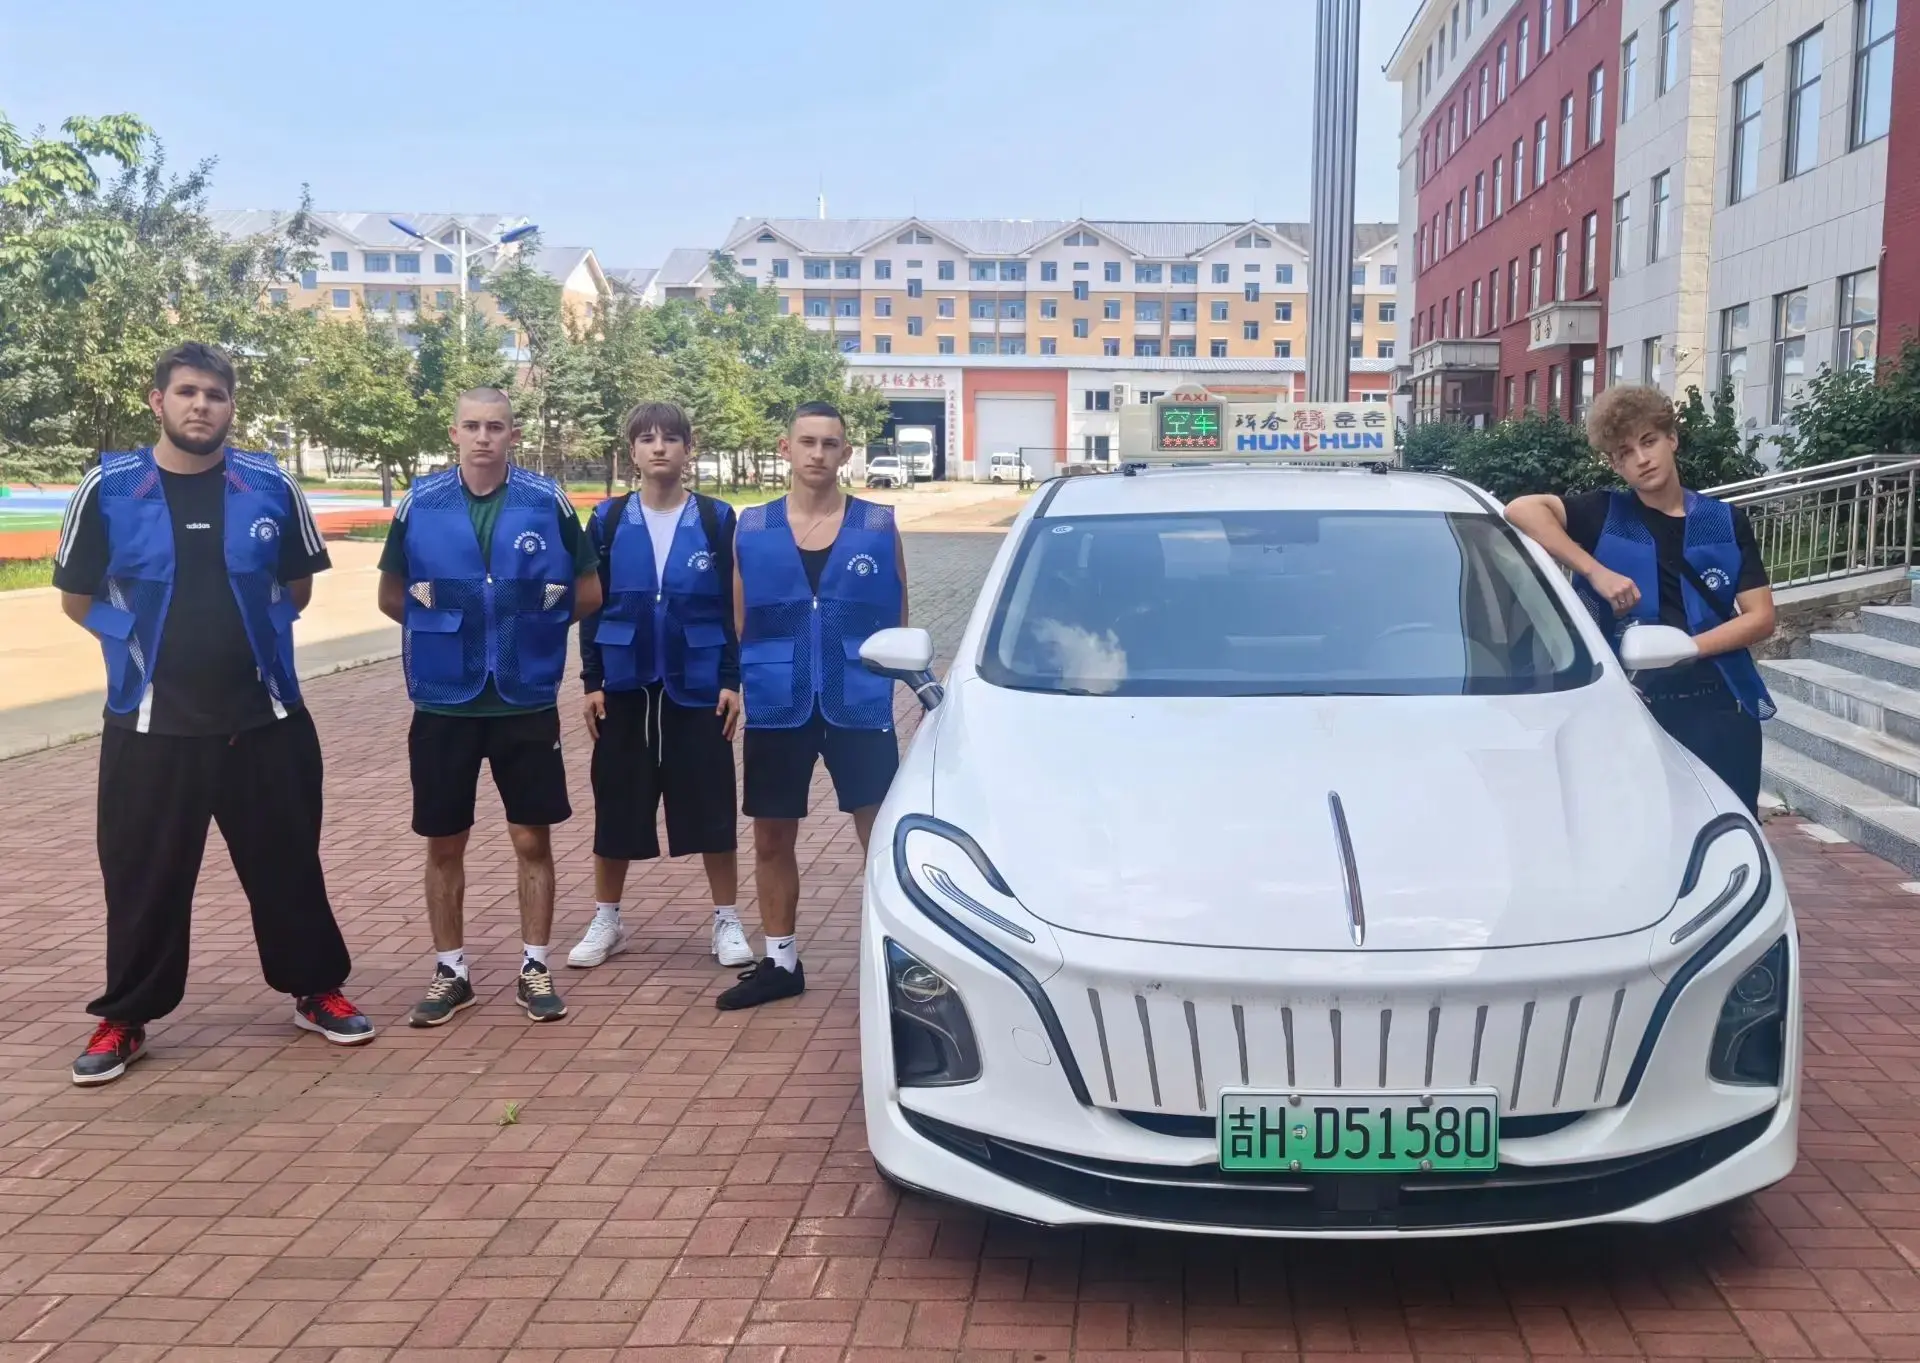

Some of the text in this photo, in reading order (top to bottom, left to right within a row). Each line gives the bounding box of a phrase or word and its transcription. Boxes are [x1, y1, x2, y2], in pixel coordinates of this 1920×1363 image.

[1172, 393, 1208, 402] TAXI
[1164, 408, 1218, 436] 空车
[1235, 411, 1288, 432] 珲春
[1333, 410, 1386, 429] 훈춘
[1237, 431, 1383, 452] HUNCHUN
[185, 522, 211, 530] adidas
[1313, 1106, 1491, 1160] D51580
